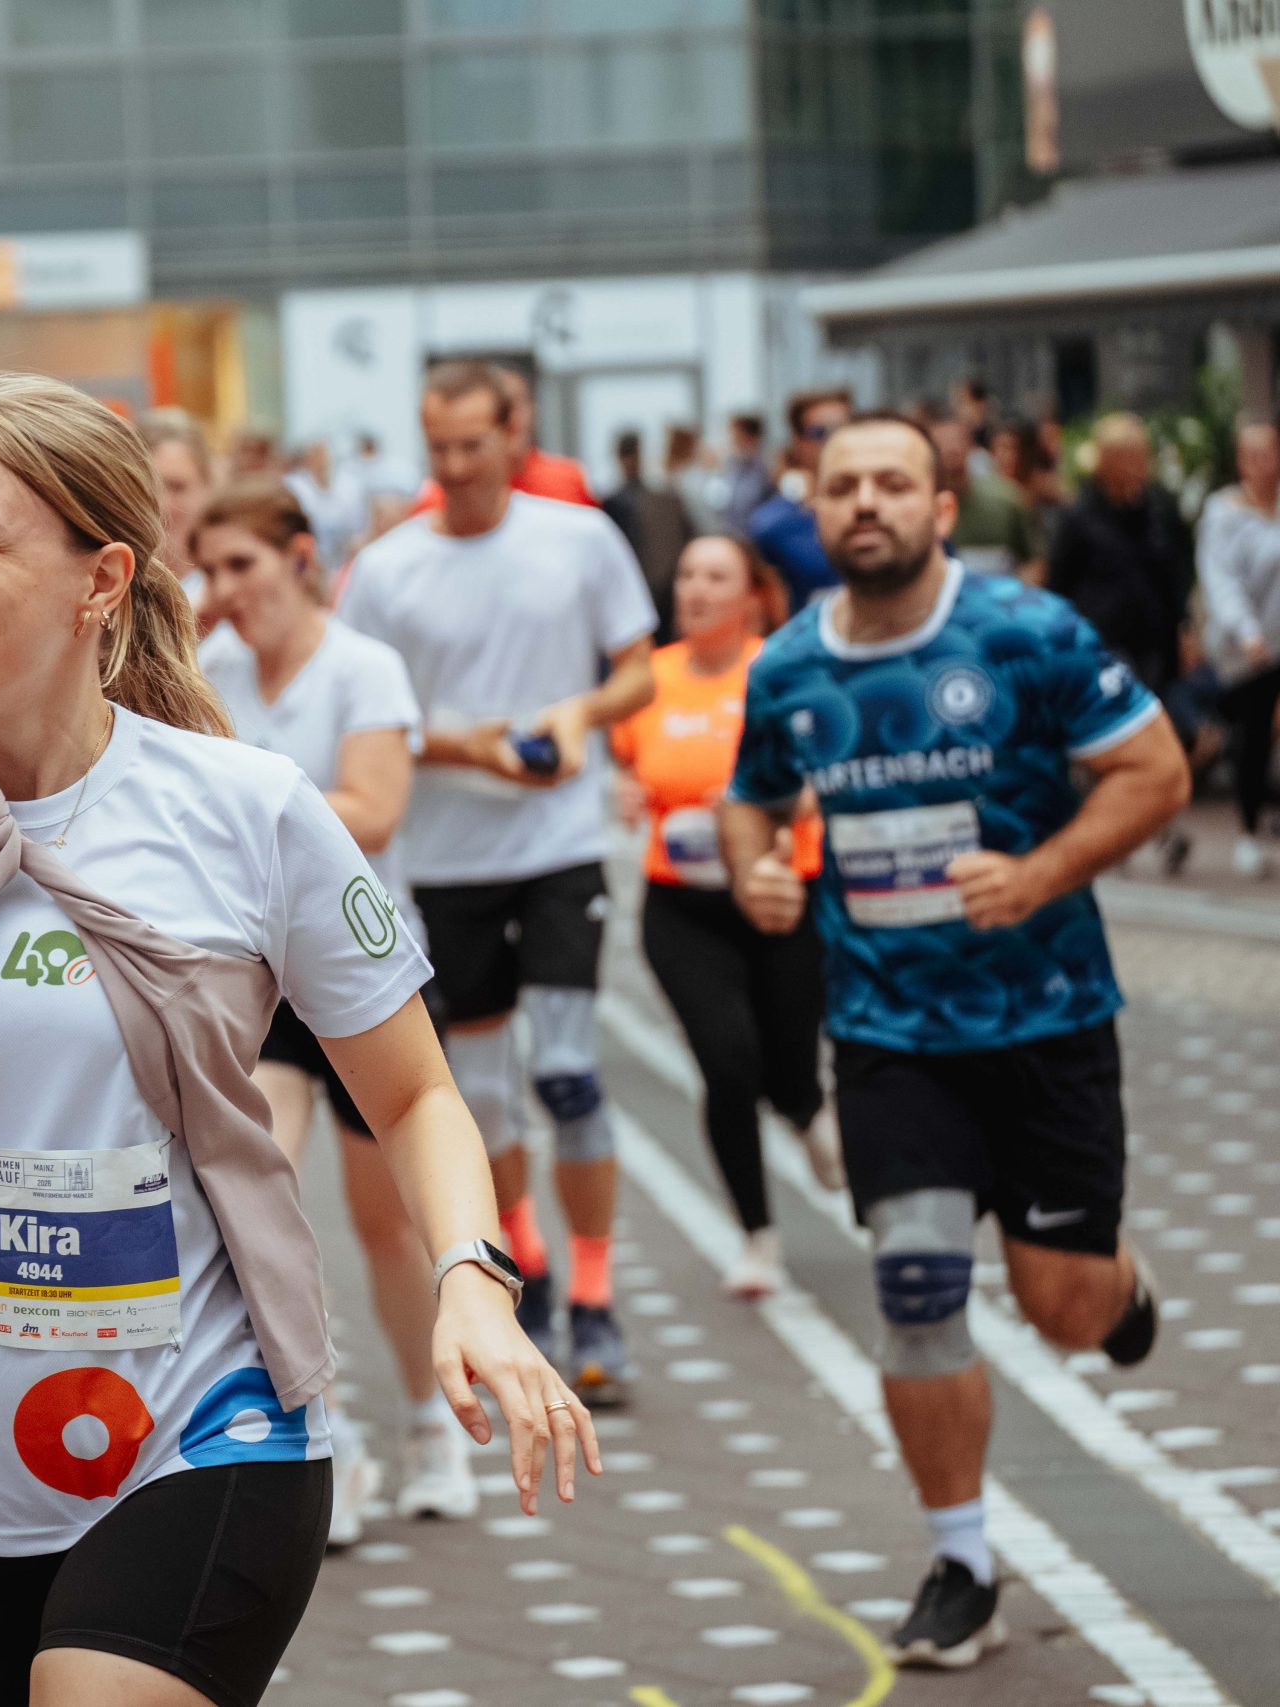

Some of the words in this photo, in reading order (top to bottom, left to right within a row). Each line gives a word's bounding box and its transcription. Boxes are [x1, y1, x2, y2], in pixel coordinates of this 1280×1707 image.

[33, 1163, 55, 1173] MAINZ
[0, 1213, 81, 1256] Kira
[16, 1261, 63, 1281] 4944
[8, 1286, 40, 1297] STARTZEIT
[58, 1290, 73, 1299] UHR
[22, 1322, 39, 1334] dm
